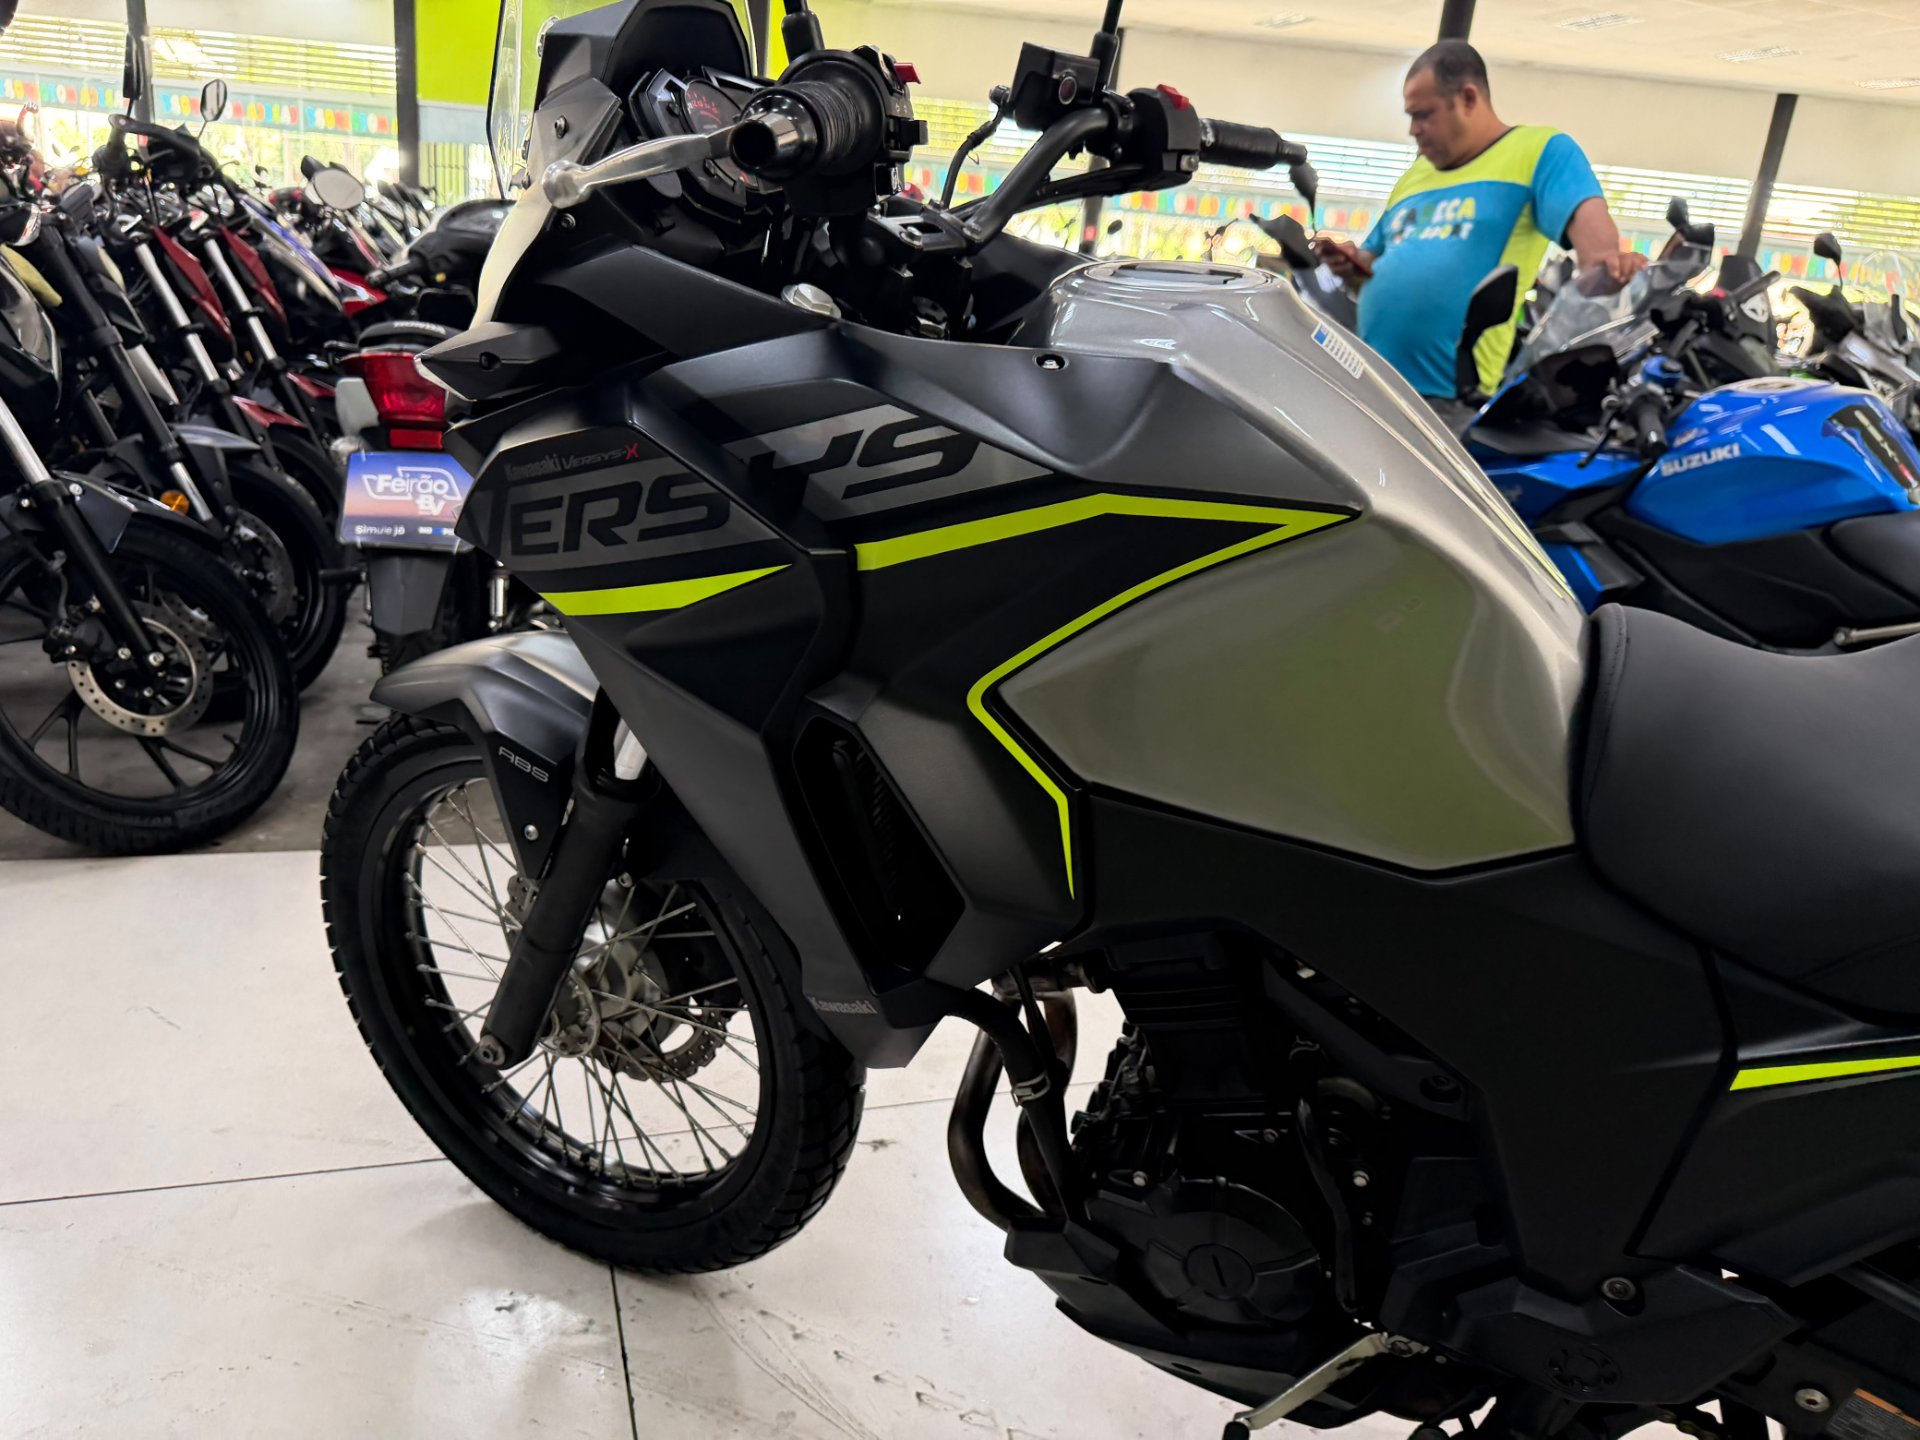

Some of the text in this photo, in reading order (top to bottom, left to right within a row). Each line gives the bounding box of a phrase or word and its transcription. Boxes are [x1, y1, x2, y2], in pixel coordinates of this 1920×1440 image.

[504, 453, 561, 482] Kawasaki
[1661, 442, 1741, 477] SUZUKI
[376, 473, 449, 495] Feirão
[498, 745, 550, 782] ABS
[807, 996, 878, 1014] Kawasaki
